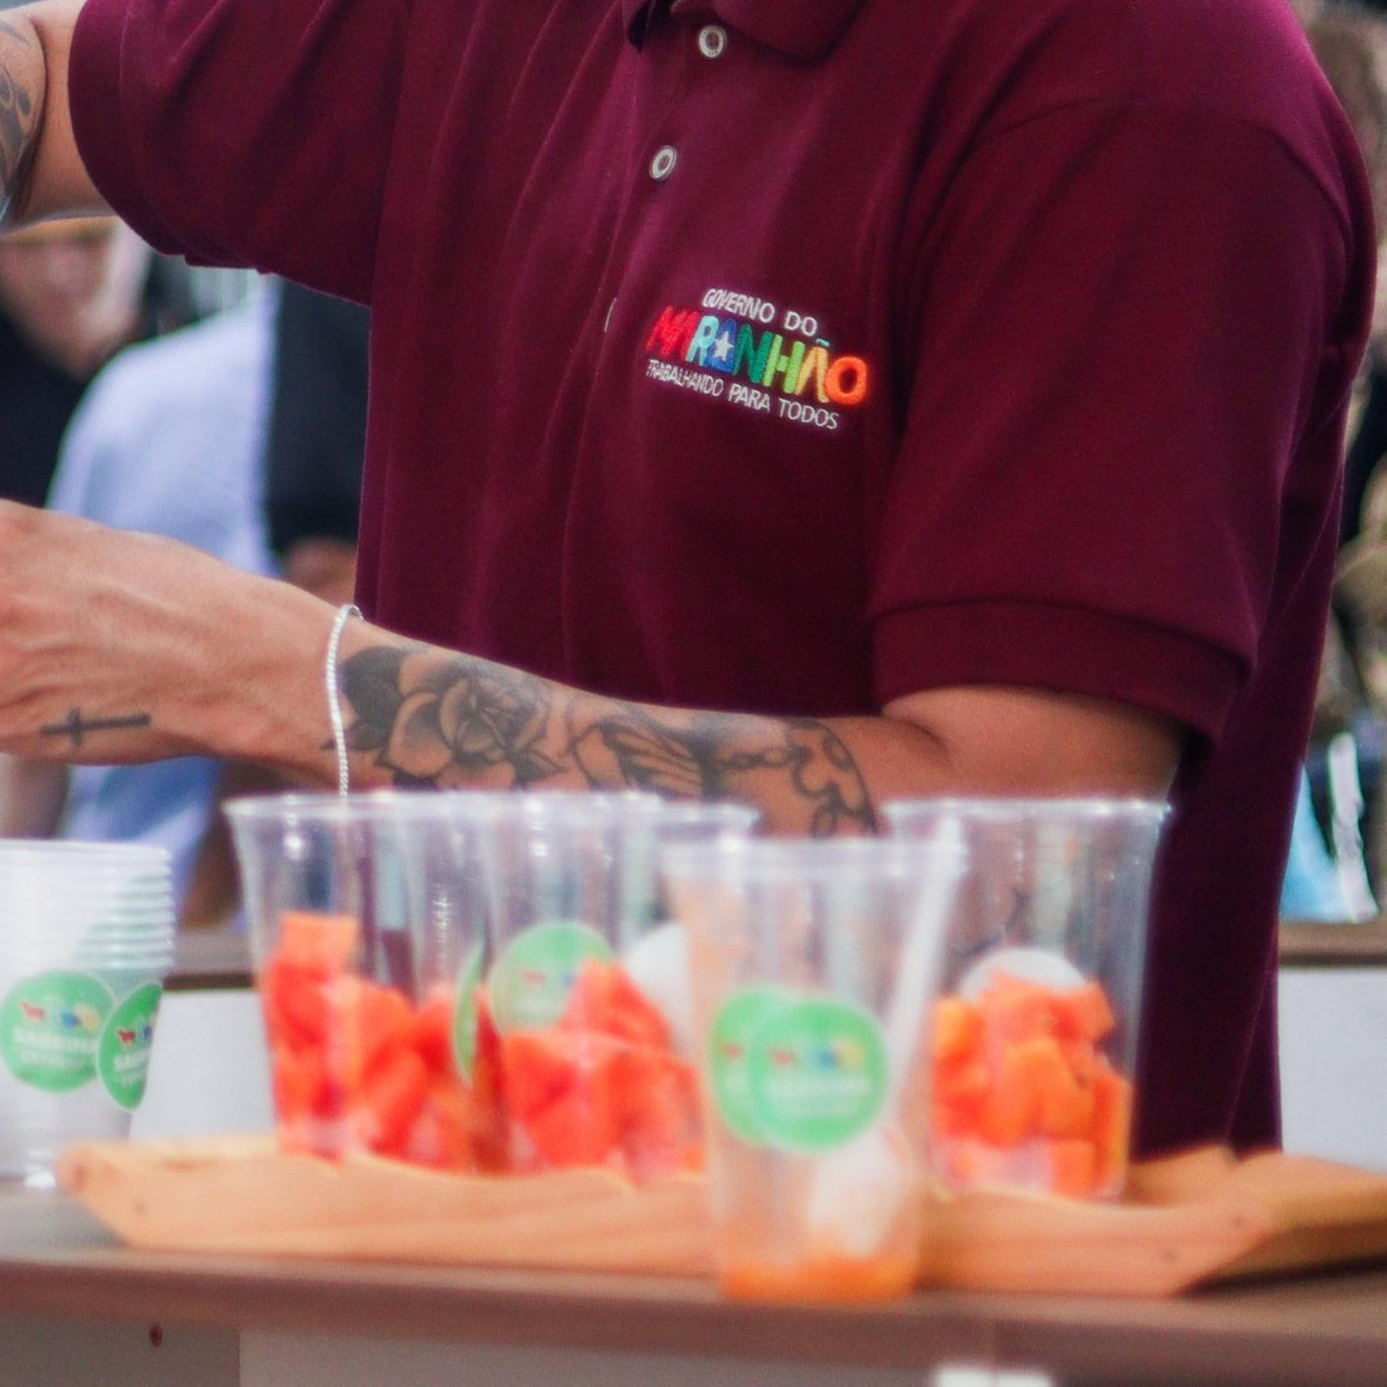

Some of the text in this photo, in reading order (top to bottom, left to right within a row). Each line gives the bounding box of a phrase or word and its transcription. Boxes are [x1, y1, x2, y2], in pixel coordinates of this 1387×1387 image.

[701, 287, 819, 338] GOVERNO DO
[645, 304, 869, 405] MARANHÃO
[646, 358, 840, 431] TRABALHANDO PARA TODOS
